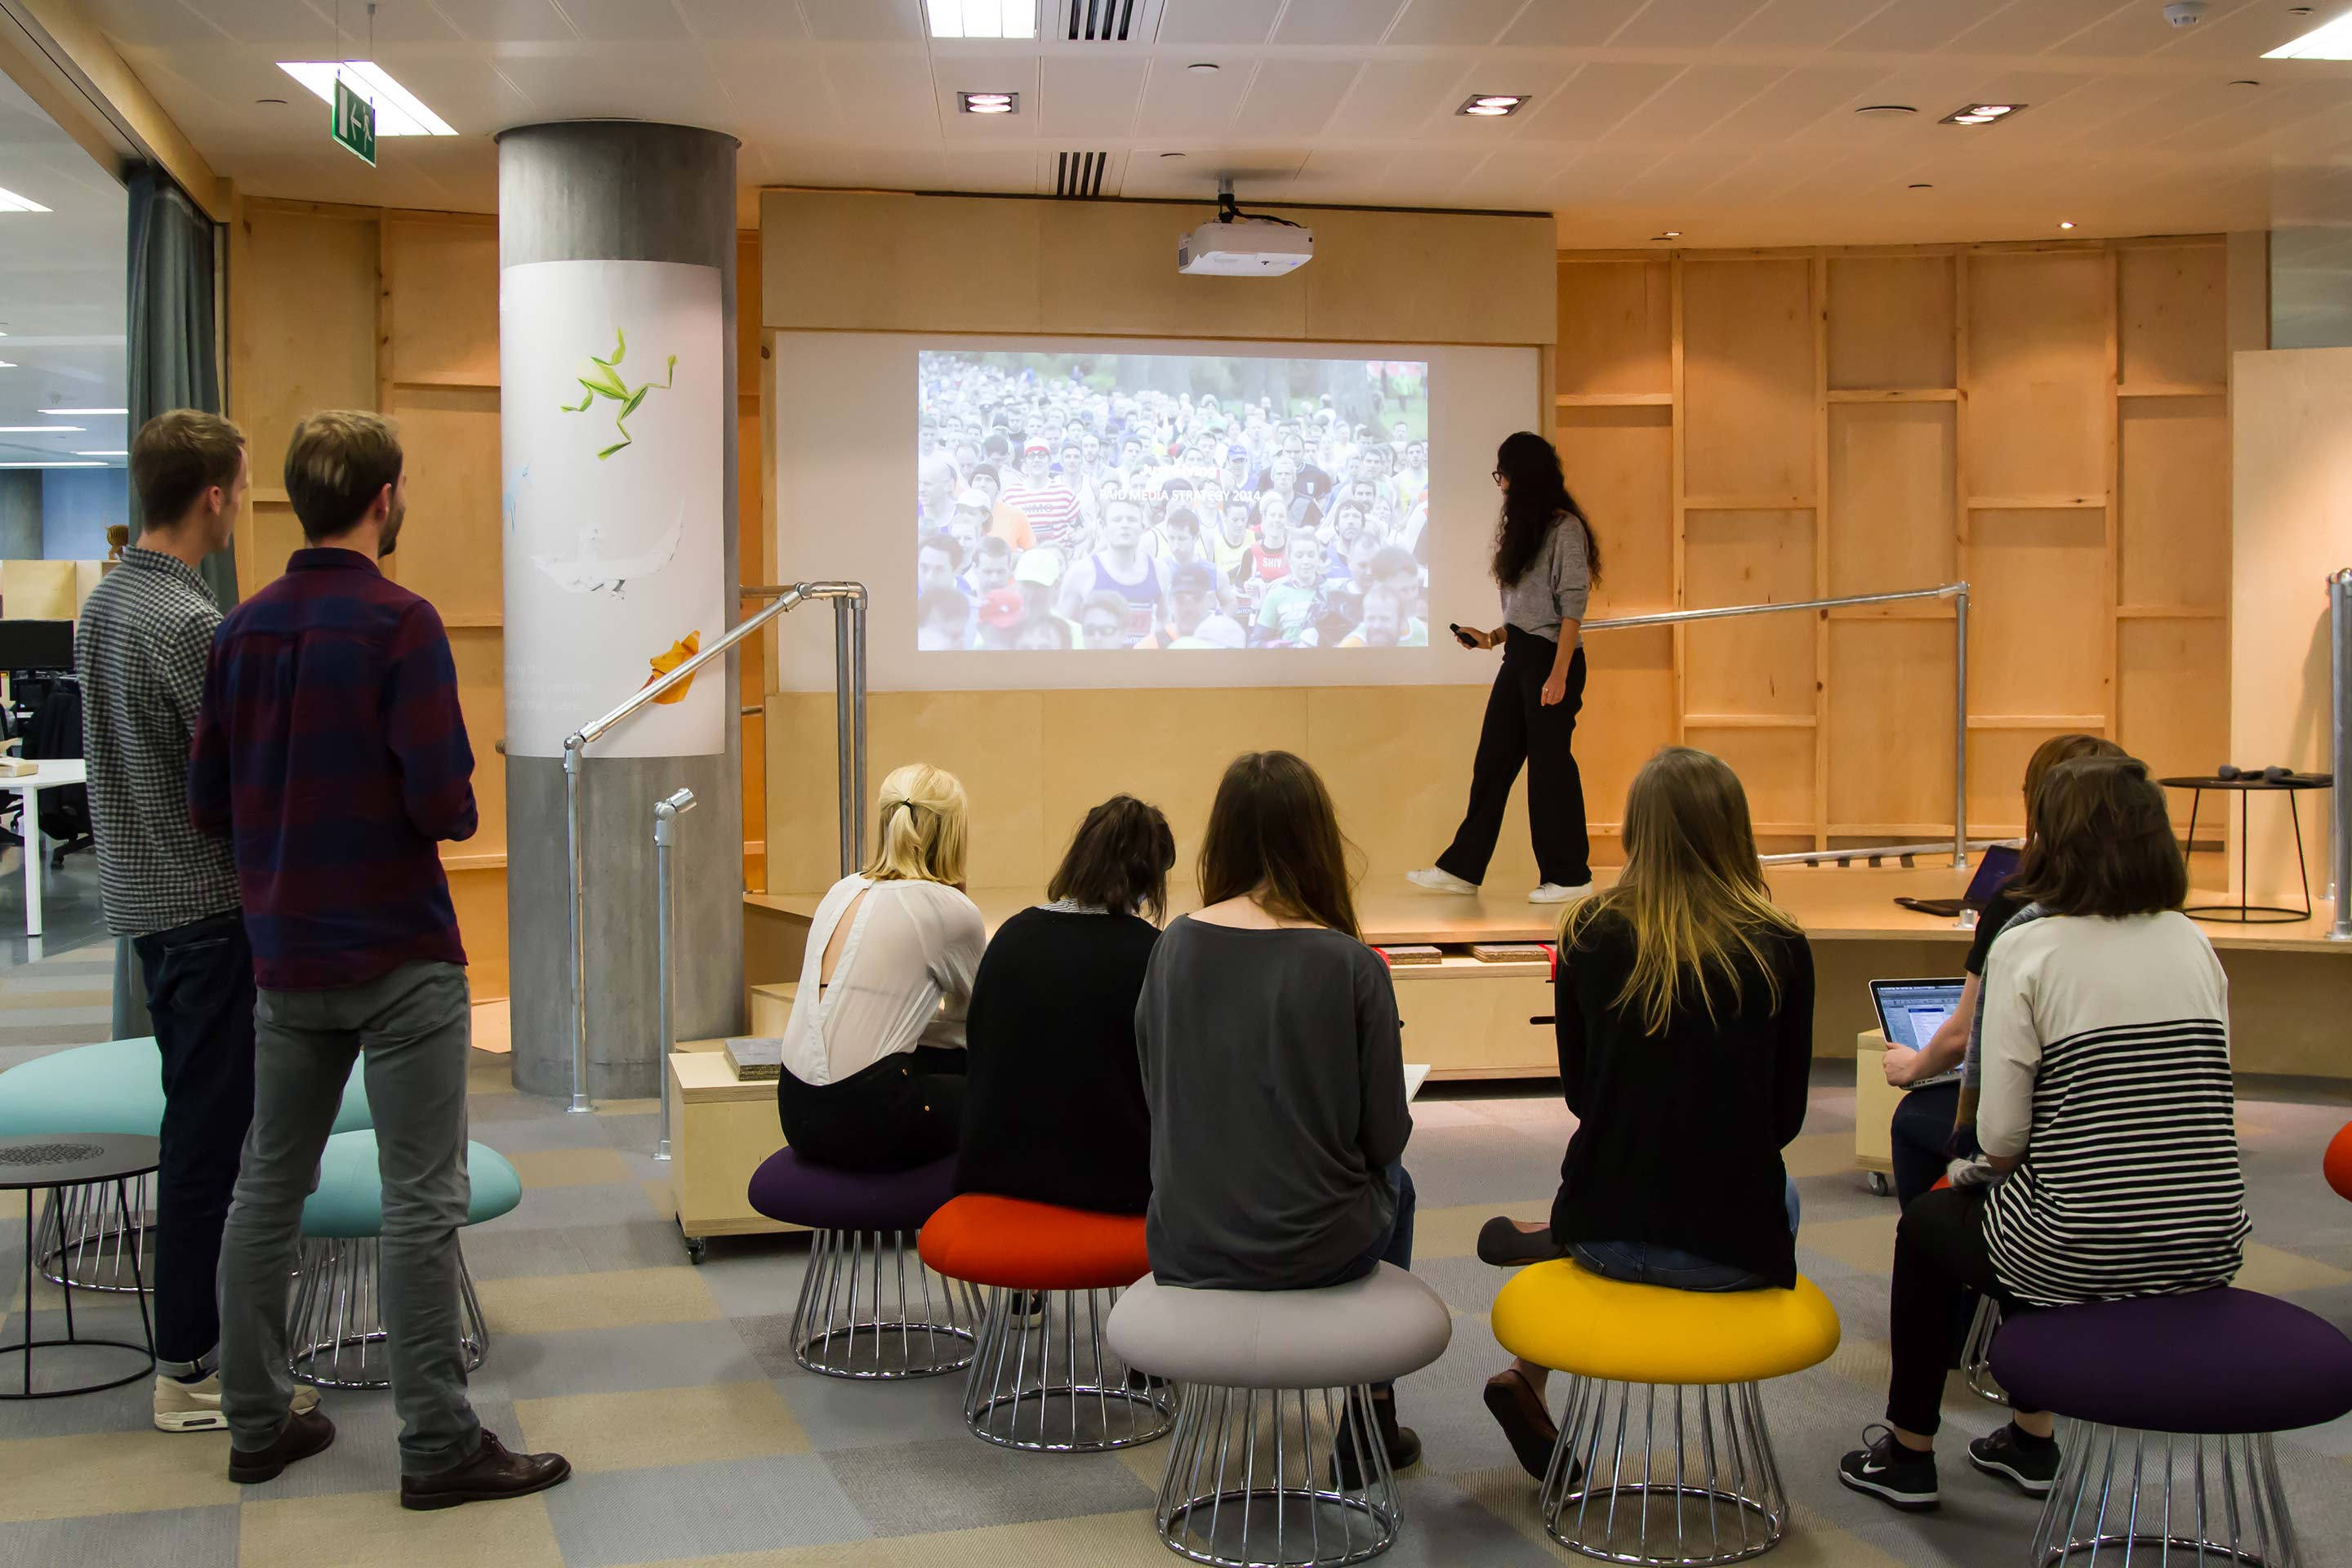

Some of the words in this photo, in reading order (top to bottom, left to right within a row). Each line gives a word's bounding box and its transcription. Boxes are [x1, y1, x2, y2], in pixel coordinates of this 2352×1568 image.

[1099, 489, 1126, 501] PAID
[1129, 489, 1169, 501] MEDIA
[1171, 490, 1231, 501] STRATEGY
[1232, 490, 1262, 501] 2014
[1262, 557, 1283, 569] SHIV
